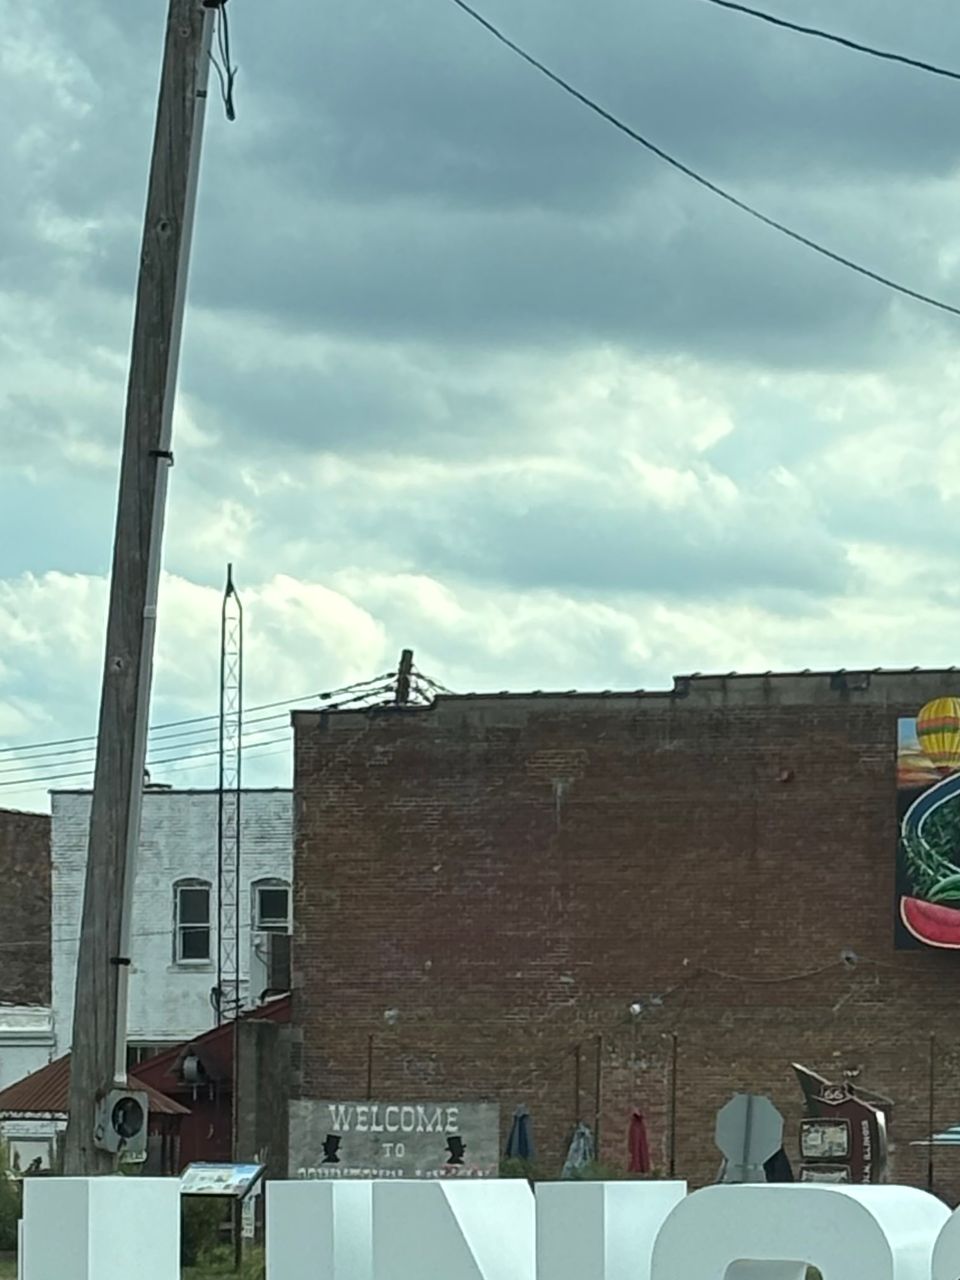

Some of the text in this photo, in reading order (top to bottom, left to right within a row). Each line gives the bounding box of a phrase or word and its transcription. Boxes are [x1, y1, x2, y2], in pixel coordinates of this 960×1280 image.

[824, 1089, 844, 1100] 66
[328, 1104, 459, 1132] WELCOME
[382, 1143, 405, 1158] TO
